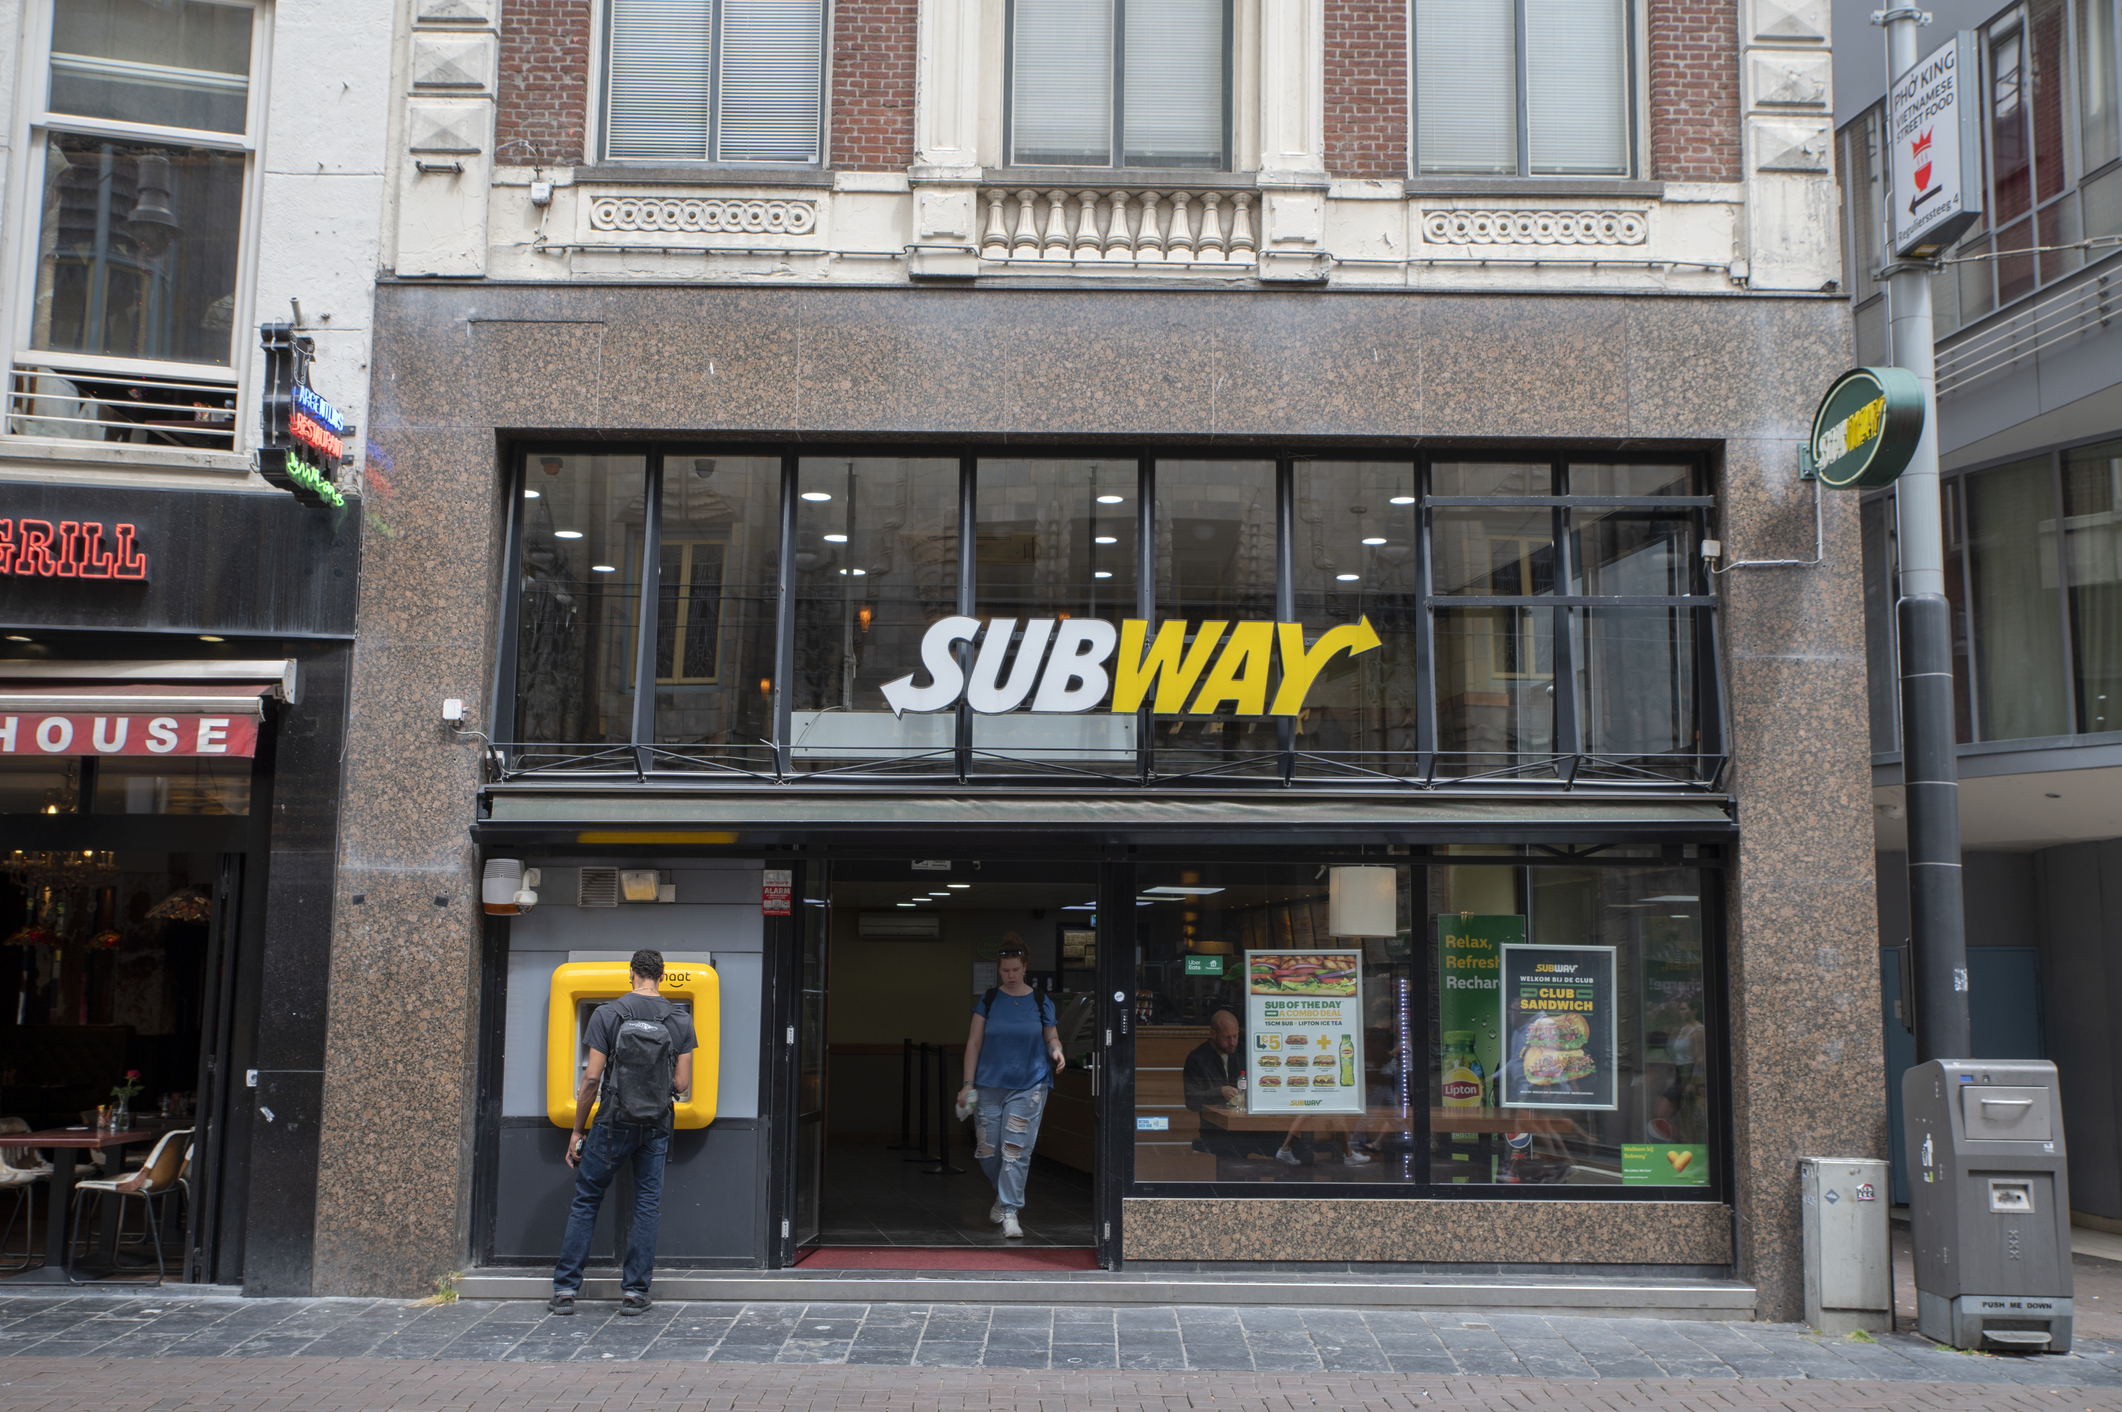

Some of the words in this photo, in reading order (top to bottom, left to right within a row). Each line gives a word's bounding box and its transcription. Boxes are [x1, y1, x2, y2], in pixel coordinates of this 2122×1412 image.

[1920, 50, 1954, 89] KING
[1896, 75, 1953, 129] VIETNAMESE
[1896, 112, 1924, 144] STREET
[1925, 92, 1954, 120] FOOD
[1898, 199, 1952, 243] Regulierssteeg
[1952, 192, 1959, 204] 4
[1814, 394, 1886, 472] SUBWAY
[880, 612, 1382, 720] SUBWAY
[1445, 934, 1492, 950] Relax,
[1446, 975, 1500, 989] Rechar
[1535, 964, 1578, 973] SUBWAY
[1520, 999, 1593, 1011] SANDWICH
[1539, 988, 1575, 998] CLUB
[1445, 1085, 1476, 1096] Lipton
